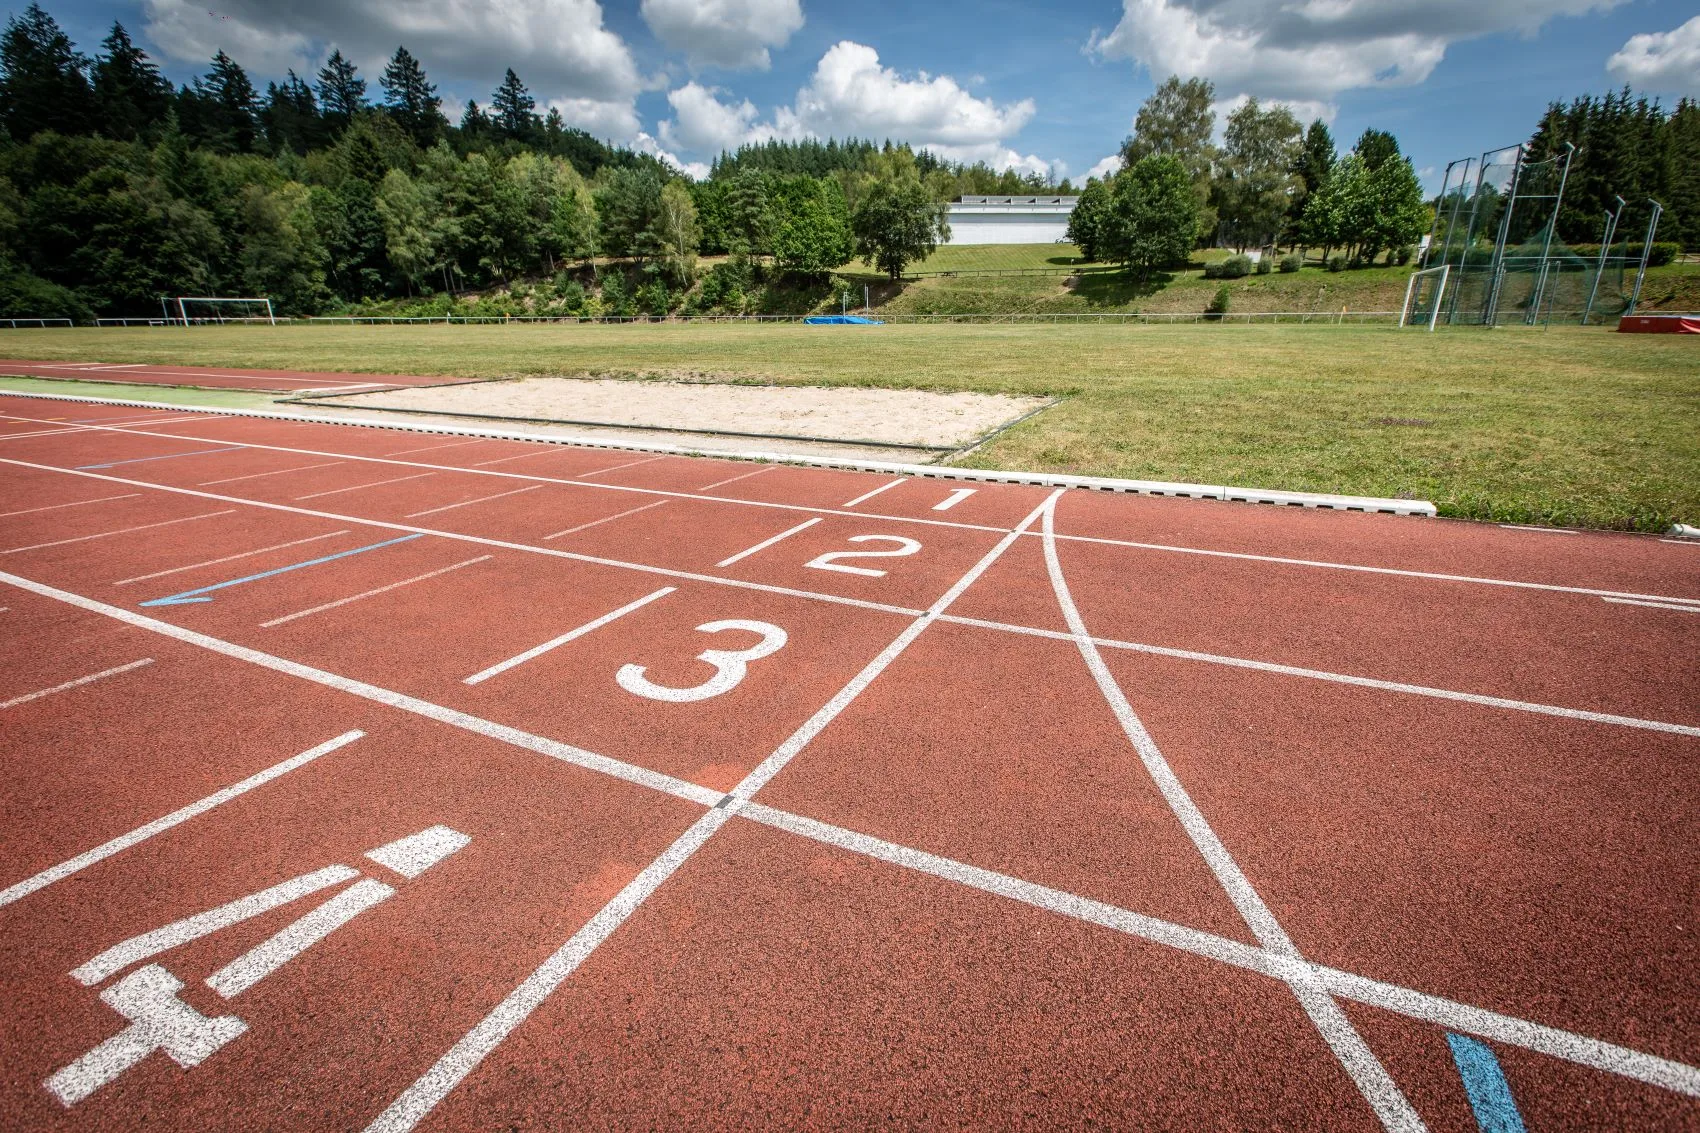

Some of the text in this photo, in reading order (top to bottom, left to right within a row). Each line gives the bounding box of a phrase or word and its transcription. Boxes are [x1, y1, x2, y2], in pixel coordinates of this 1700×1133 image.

[932, 488, 979, 511] 1
[803, 535, 922, 577] 2
[615, 619, 788, 702] 3
[43, 824, 472, 1108] 4
